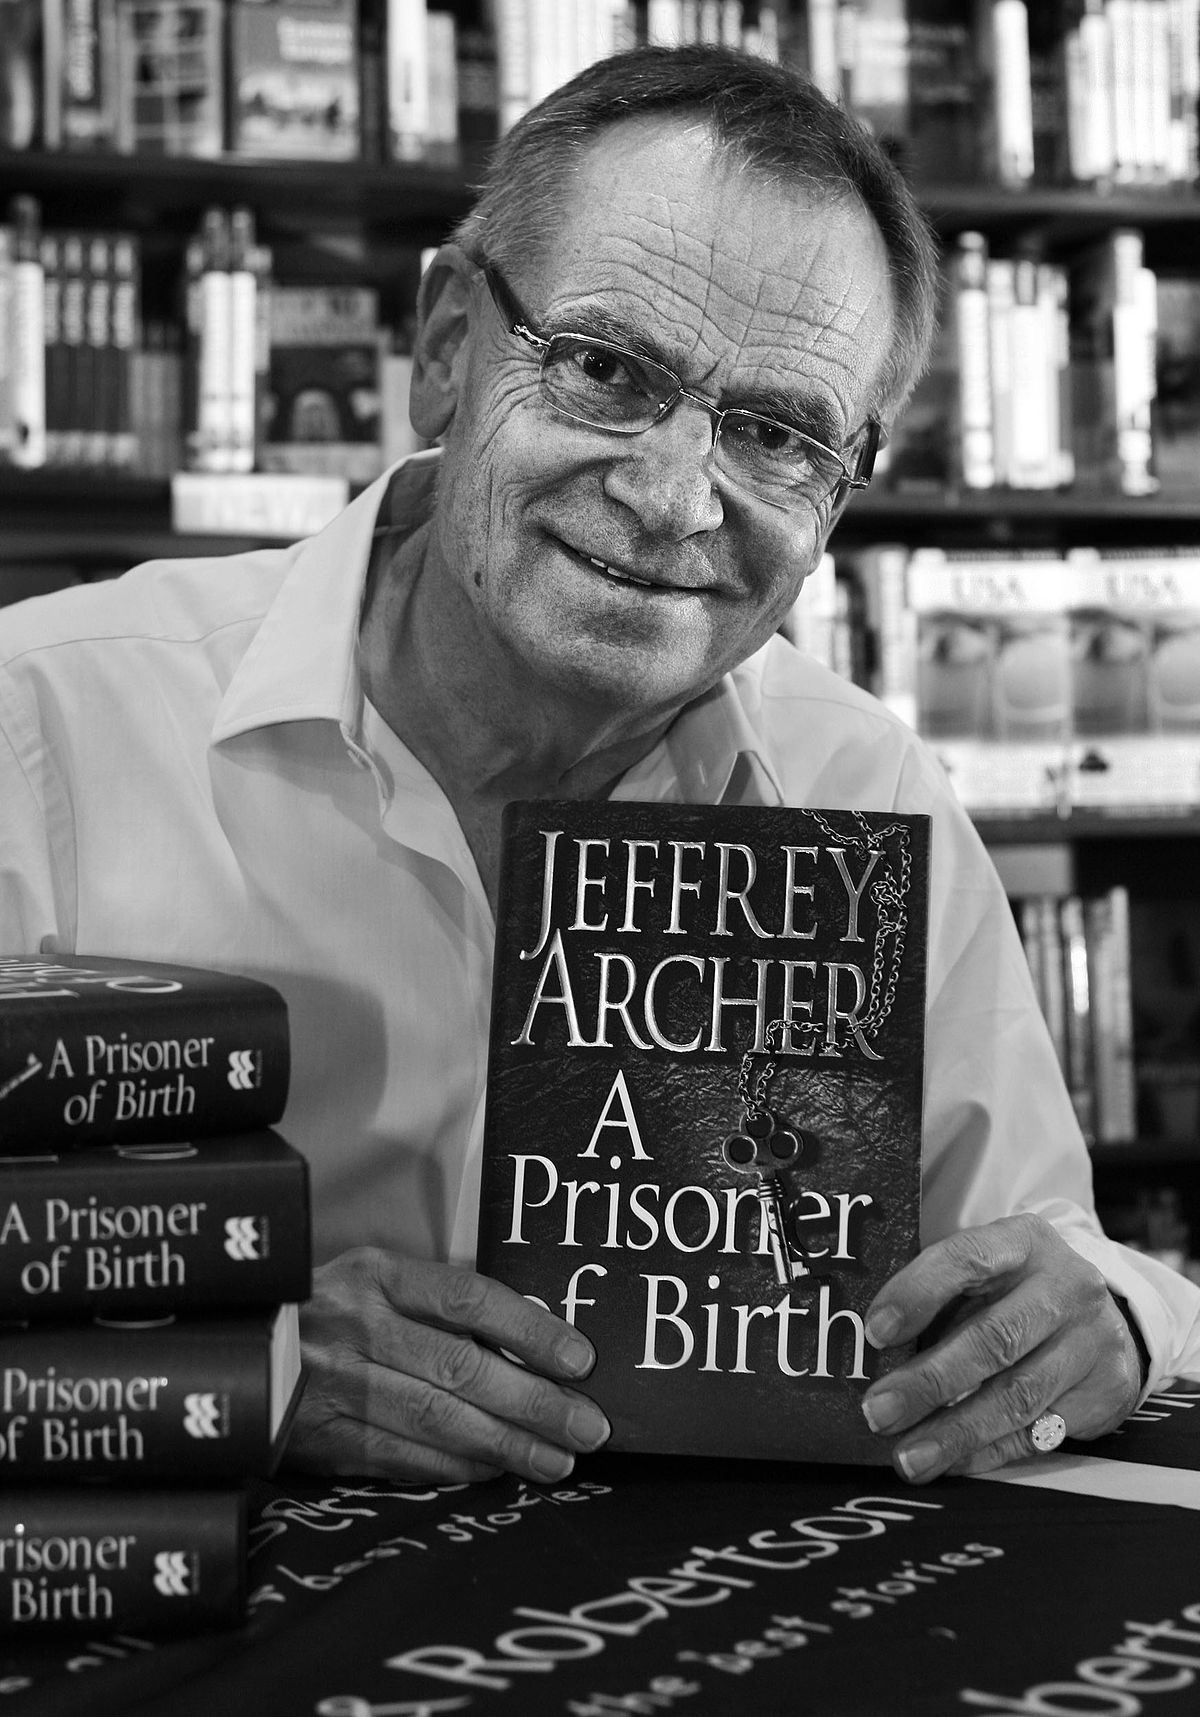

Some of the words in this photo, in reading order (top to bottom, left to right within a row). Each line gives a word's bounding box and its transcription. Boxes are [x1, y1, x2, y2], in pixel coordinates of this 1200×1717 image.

[520, 830, 886, 960] JEFFREY
[510, 928, 885, 1061] ARCHER
[48, 1037, 74, 1079] A
[86, 1032, 215, 1076] Prisoner
[64, 1079, 107, 1126] of
[115, 1073, 196, 1121] Birth
[577, 1069, 654, 1160] A
[0, 1202, 30, 1245] A
[46, 1196, 207, 1242] Prisoner
[502, 1155, 873, 1260] Prisoner
[21, 1245, 72, 1295] of
[86, 1240, 186, 1291] Birth
[635, 1273, 870, 1381] Birth
[3, 1367, 169, 1412] Prisoner
[43, 1414, 144, 1462] Birth
[12, 1573, 114, 1622] Birth
[384, 1496, 943, 1691] Robertson
[830, 1541, 1004, 1618] stories
